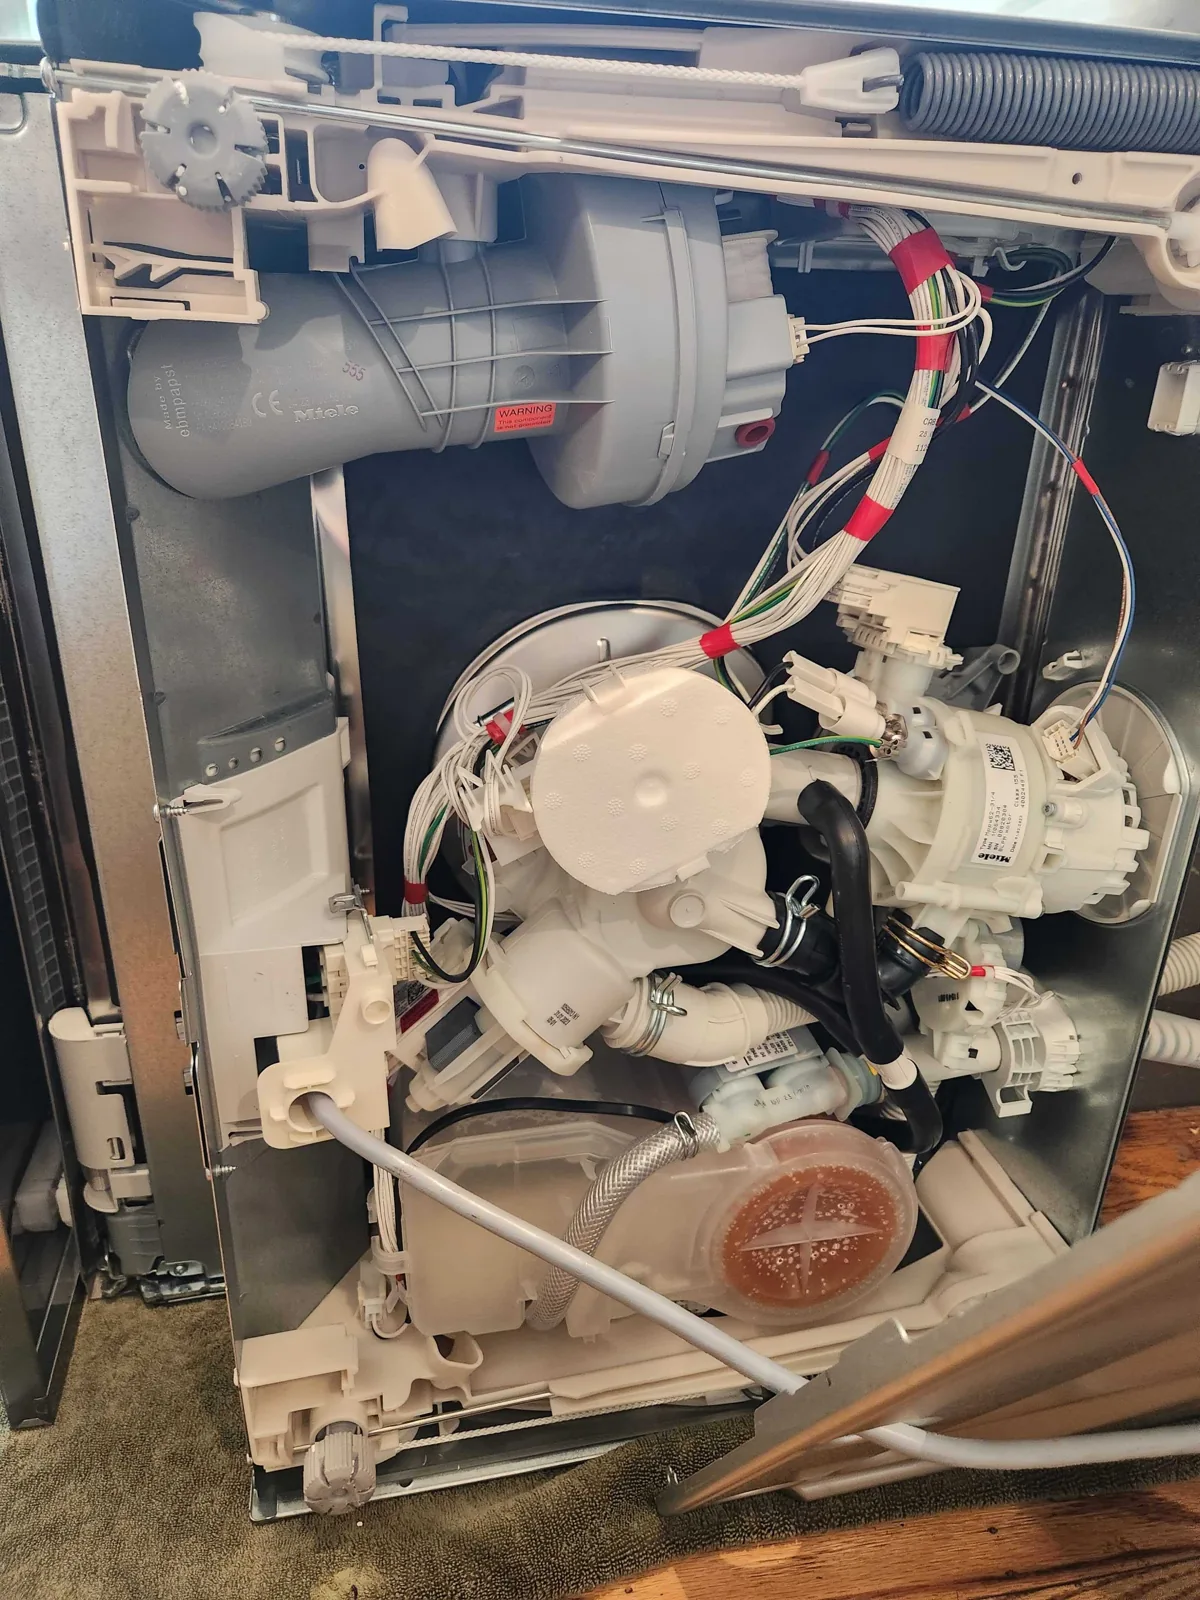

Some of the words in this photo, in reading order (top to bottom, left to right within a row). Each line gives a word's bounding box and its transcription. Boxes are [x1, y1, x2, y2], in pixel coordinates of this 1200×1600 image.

[342, 360, 366, 381] 555
[153, 374, 163, 392] by
[160, 363, 190, 438] ebmpapst
[159, 395, 172, 430] Made
[292, 404, 360, 424] Miele
[499, 404, 552, 418] WARNING
[514, 414, 552, 423] component
[518, 420, 551, 428] grounded
[980, 838, 988, 850] Type
[987, 841, 993, 850] MN
[978, 852, 1012, 864] Miele
